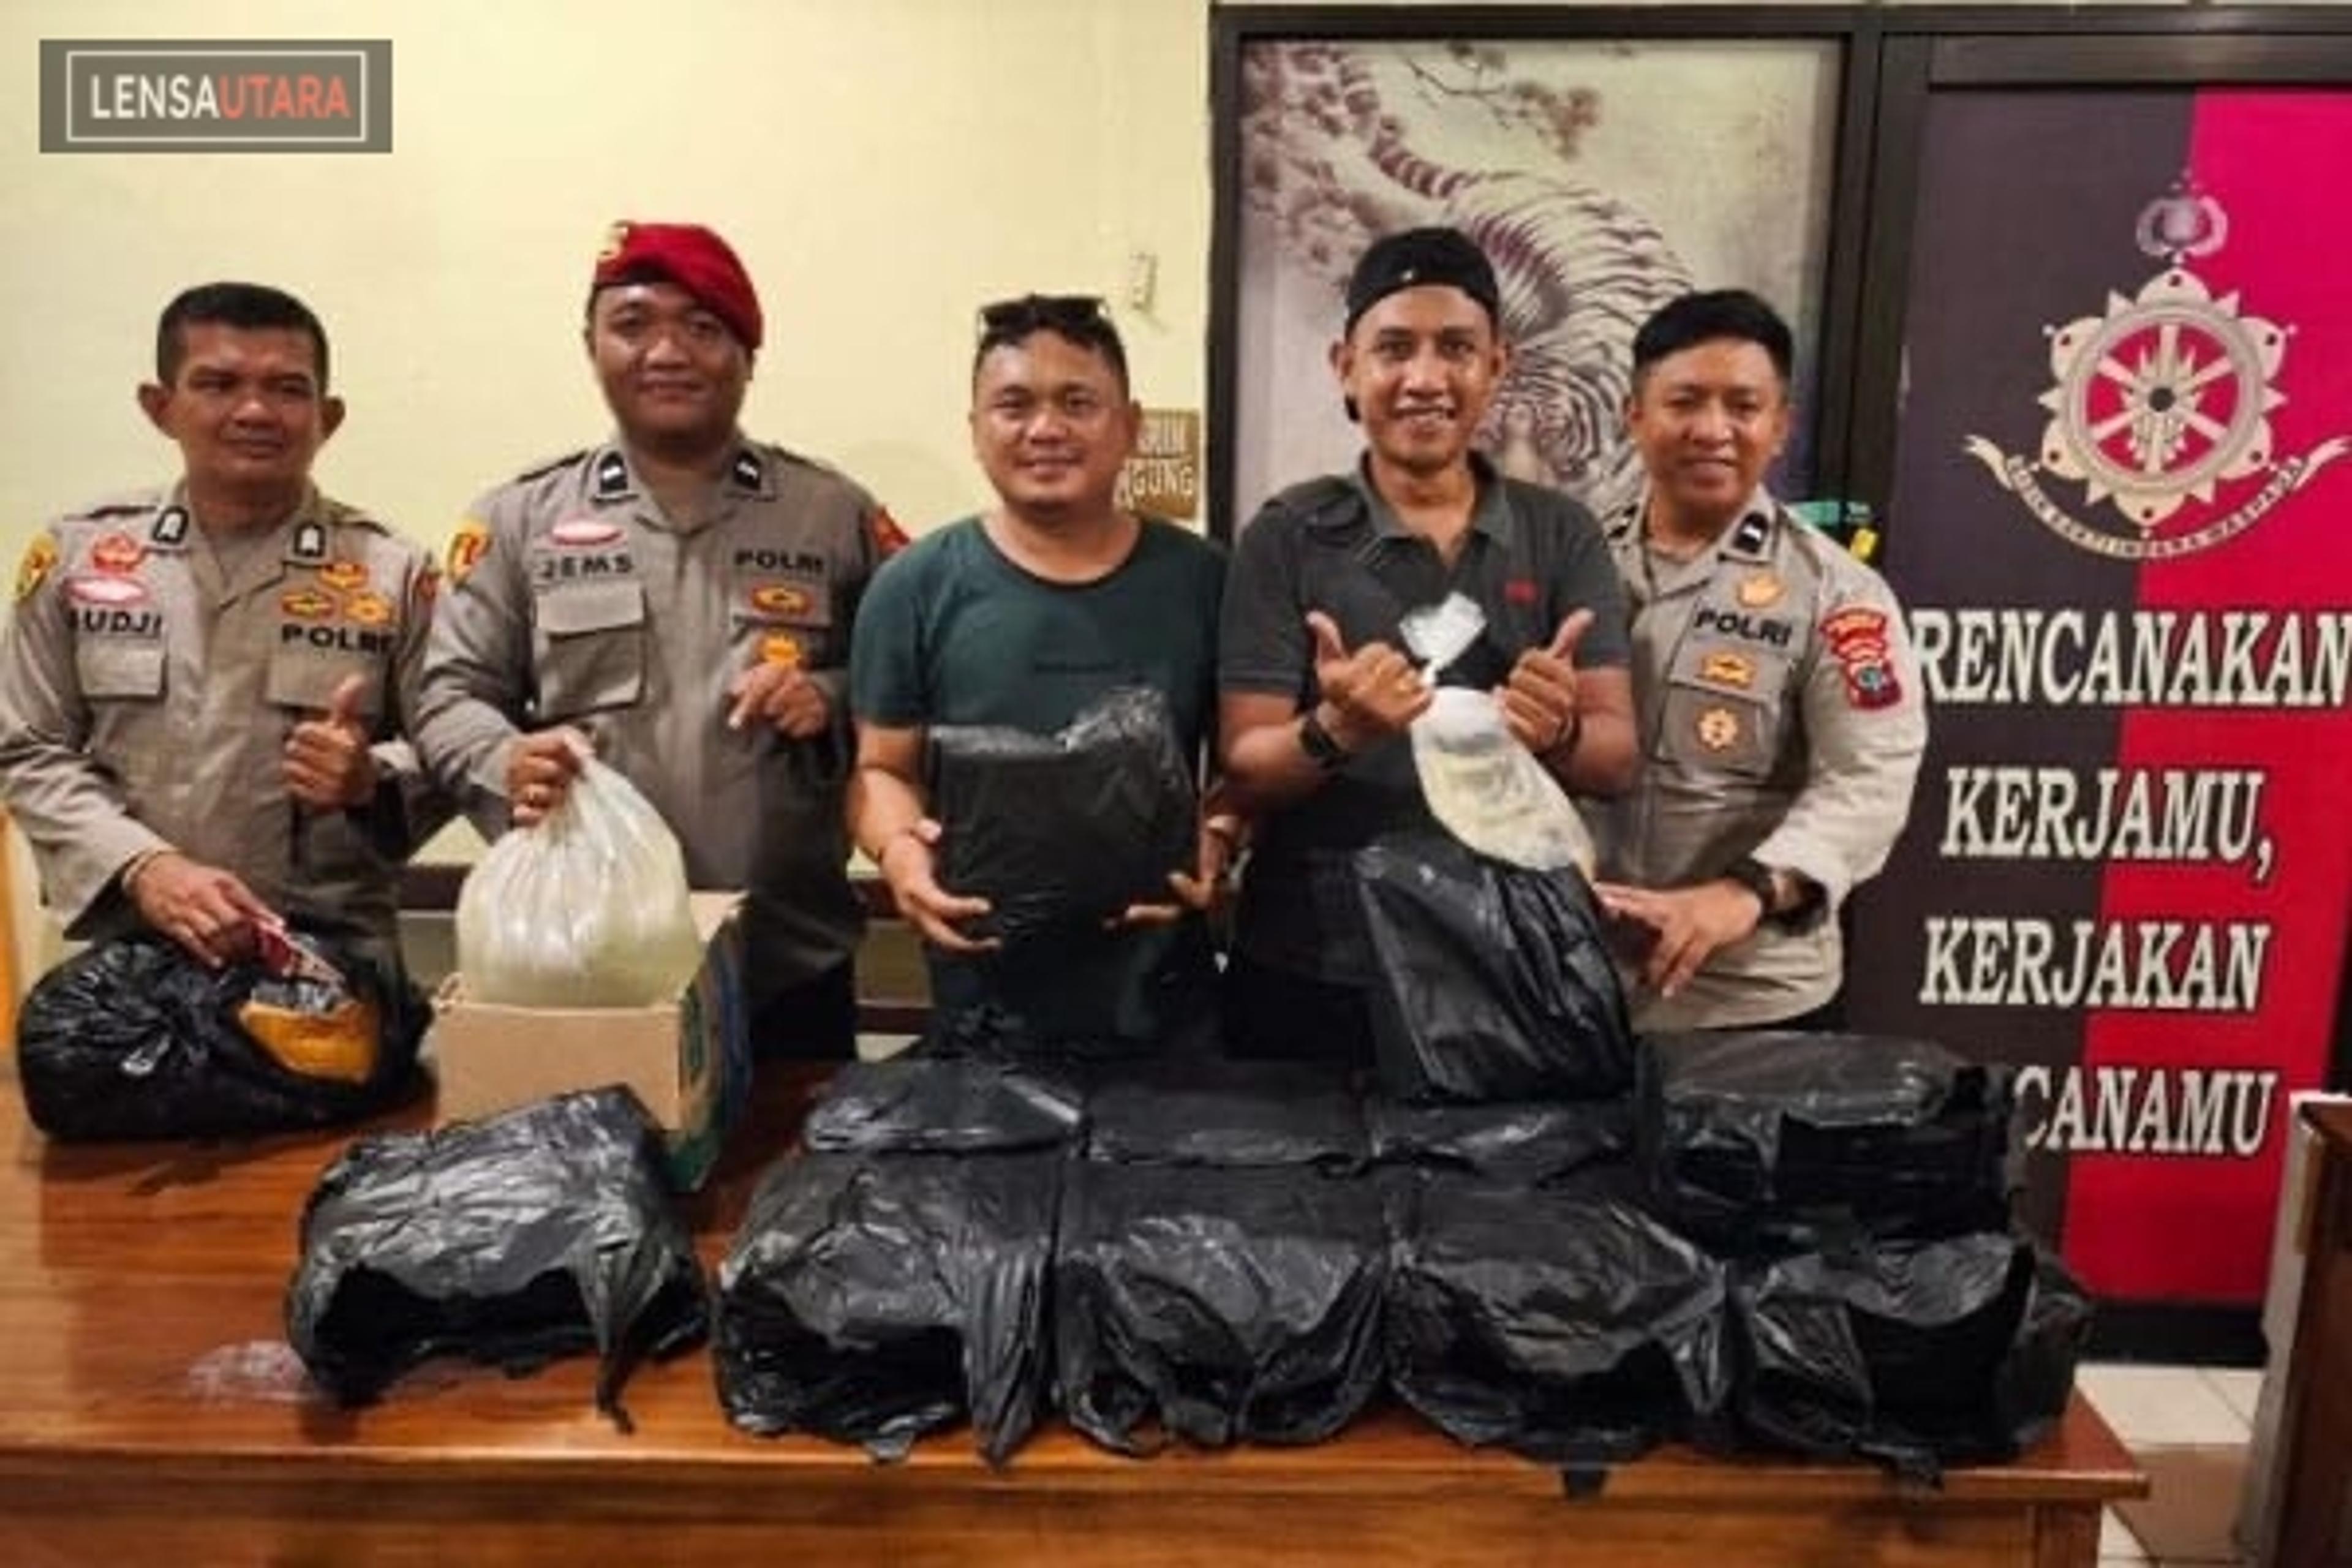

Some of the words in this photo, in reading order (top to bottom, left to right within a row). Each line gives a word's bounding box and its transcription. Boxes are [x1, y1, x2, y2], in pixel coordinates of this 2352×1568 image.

[734, 549, 824, 576] POLRI
[1694, 609, 1793, 646] POLRI
[1910, 608, 2352, 706] RENCANAKAN
[1940, 766, 2274, 881] KERJAMU,
[1918, 917, 2271, 1011] KERJAKAN
[2013, 1065, 2278, 1155] CANAMU
